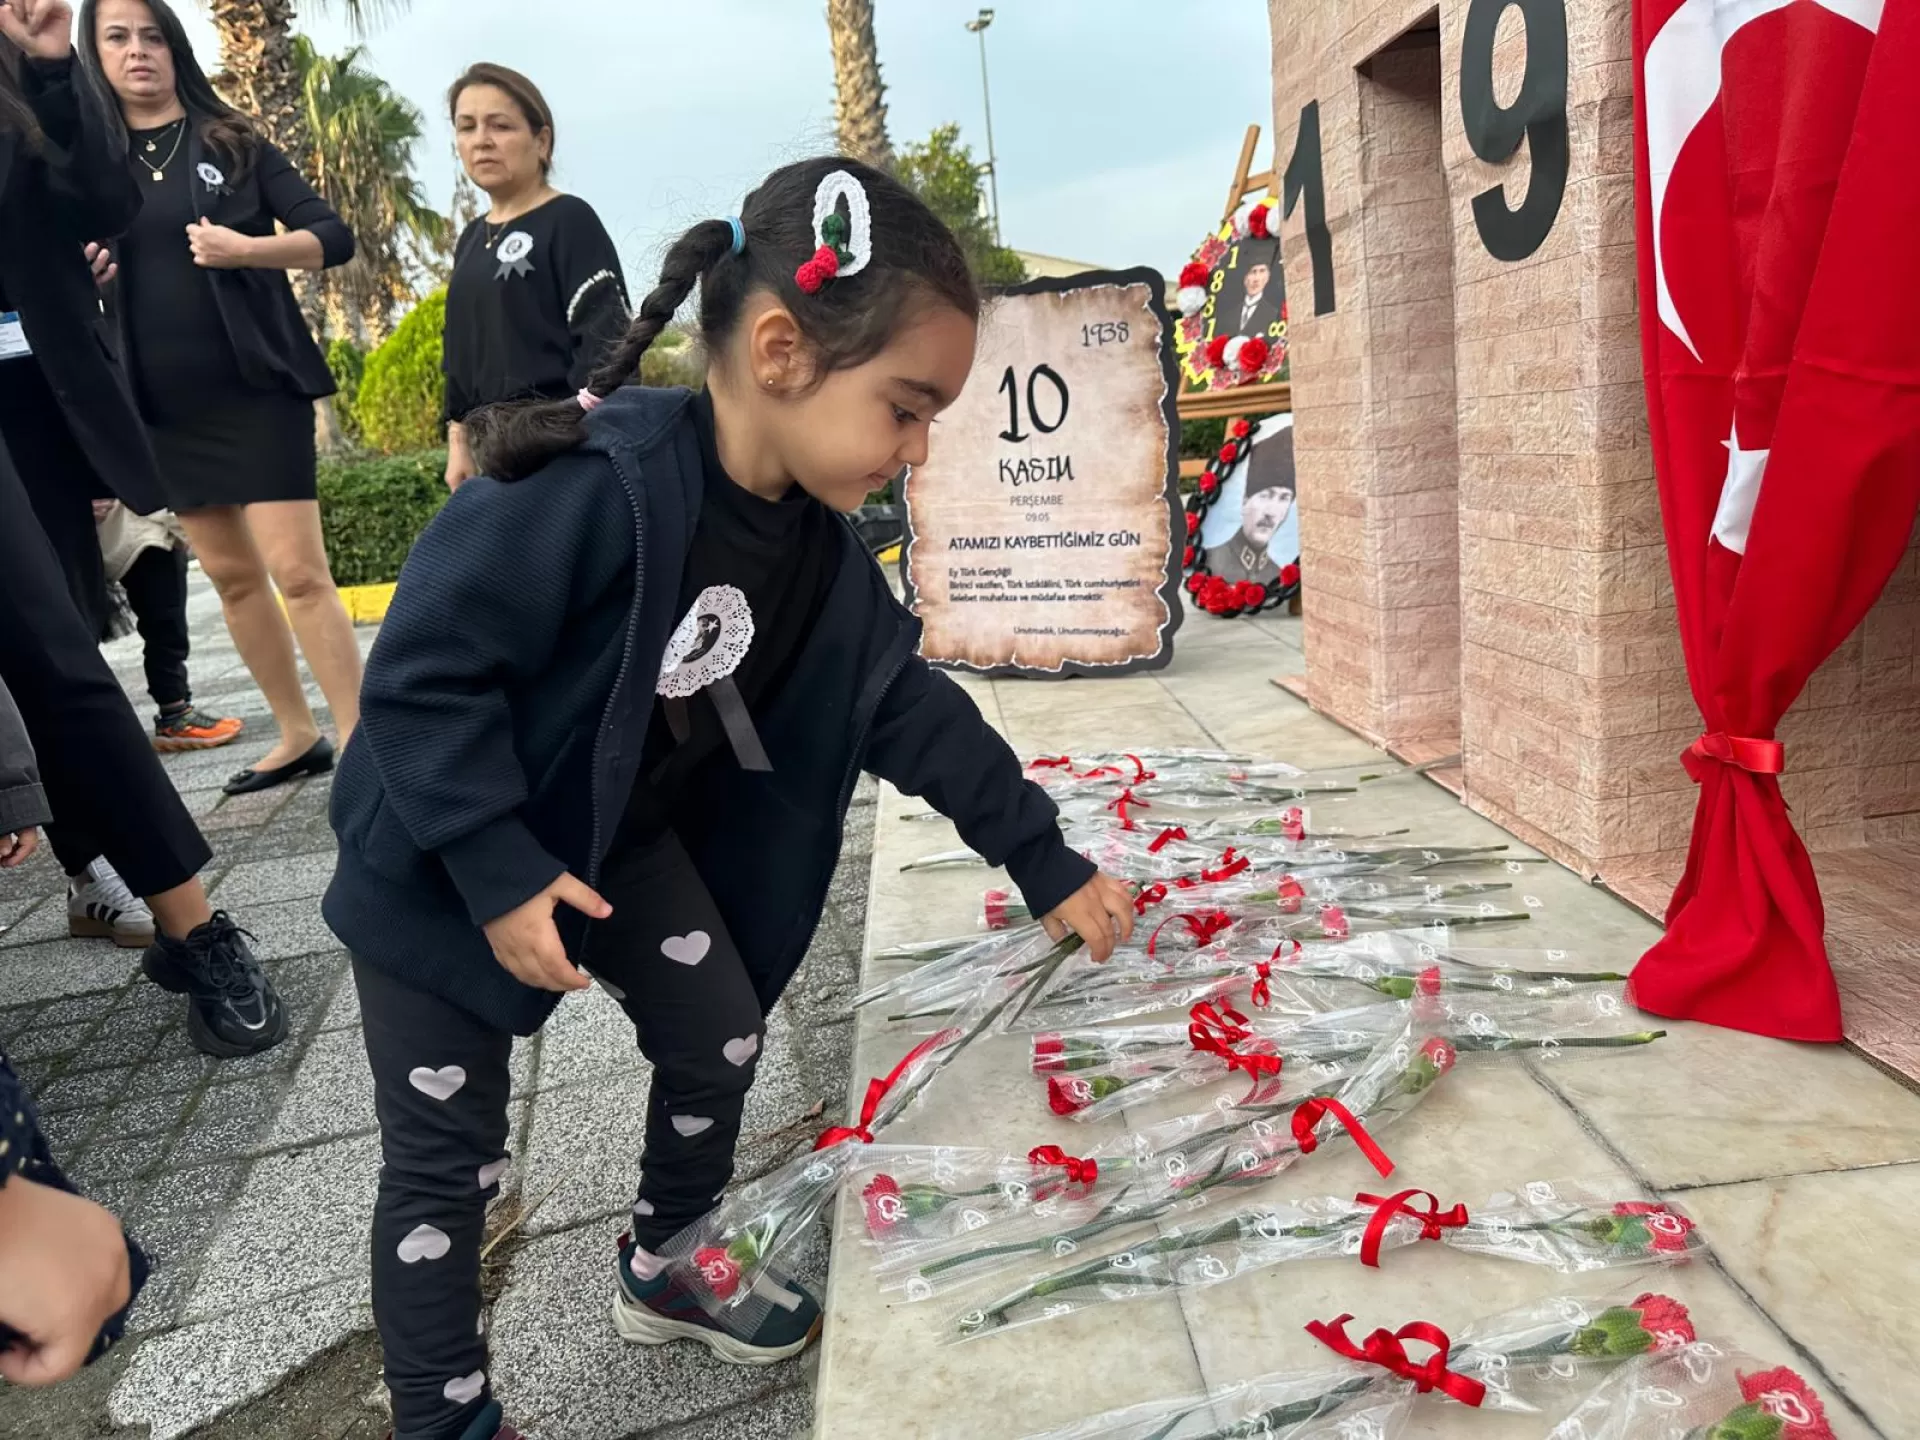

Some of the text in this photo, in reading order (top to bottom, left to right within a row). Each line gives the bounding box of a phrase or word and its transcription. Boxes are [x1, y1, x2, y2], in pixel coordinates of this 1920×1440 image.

[1082, 320, 1130, 348] 1938
[998, 363, 1069, 443] 10
[998, 454, 1075, 487] KASIM
[1009, 495, 1064, 508] PERŞEMBE
[949, 530, 1141, 550] ATAMIZI KAYBETTİĞİMİZ GÜN
[949, 567, 959, 579] Ey
[960, 567, 977, 577] Türk
[1006, 579, 1022, 589] Türk
[1064, 579, 1082, 588] Türk
[979, 592, 1017, 602] muhafaza
